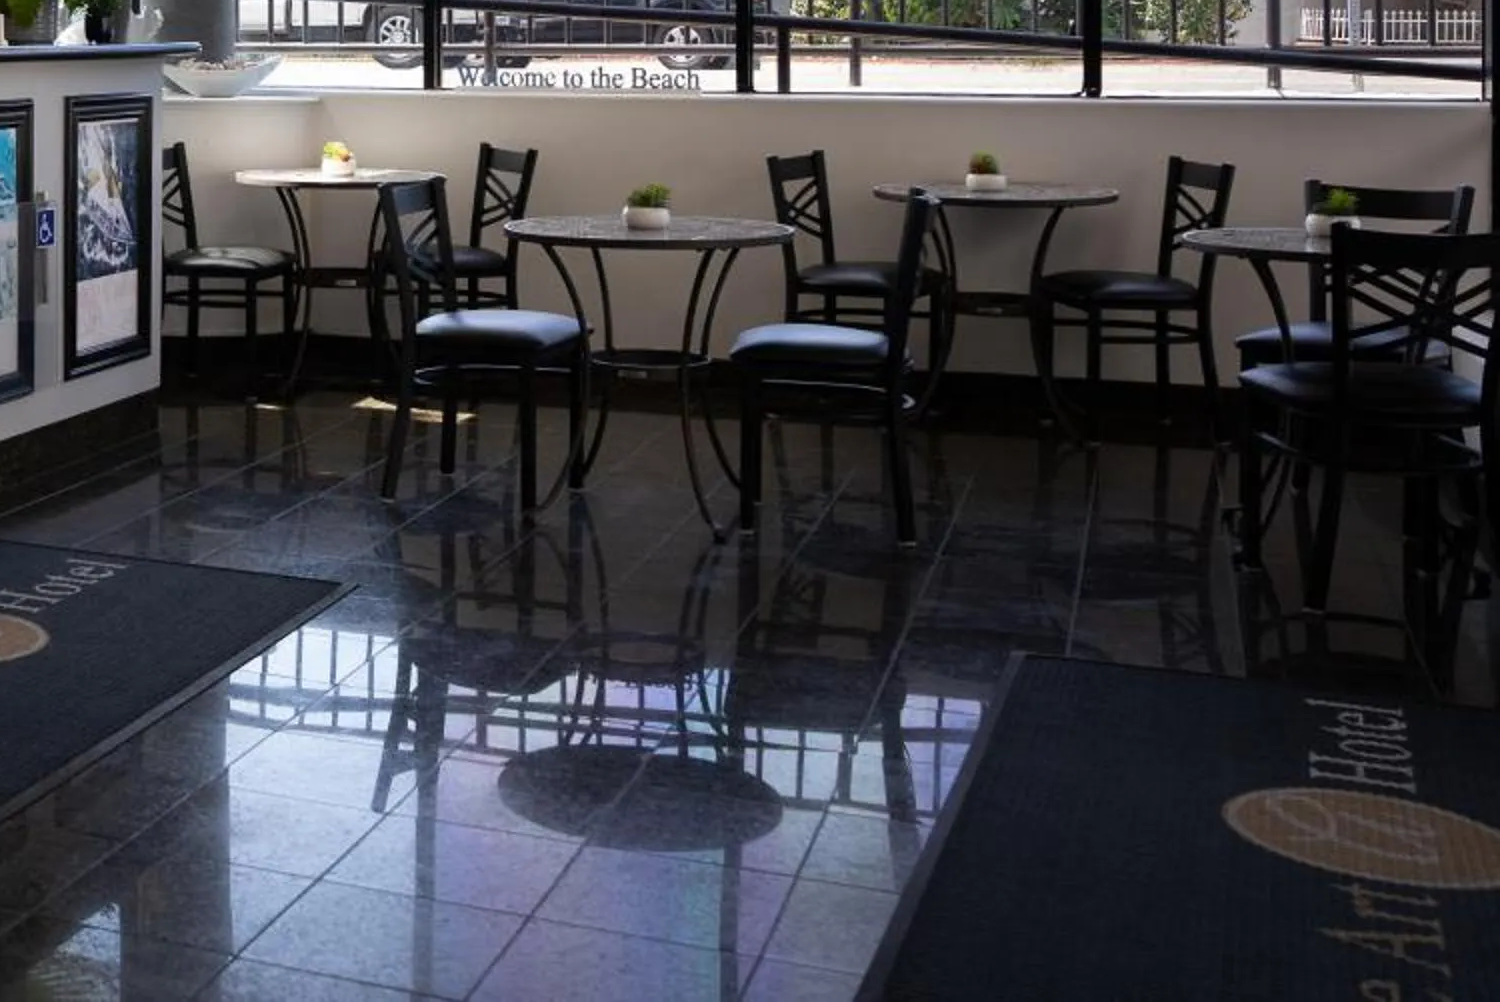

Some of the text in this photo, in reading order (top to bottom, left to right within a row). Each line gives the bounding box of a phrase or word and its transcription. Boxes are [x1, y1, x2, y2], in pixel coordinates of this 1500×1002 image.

[457, 66, 700, 90] Welcome to the Beach
[1303, 697, 1417, 795] Hotel
[1316, 883, 1453, 978] Art
